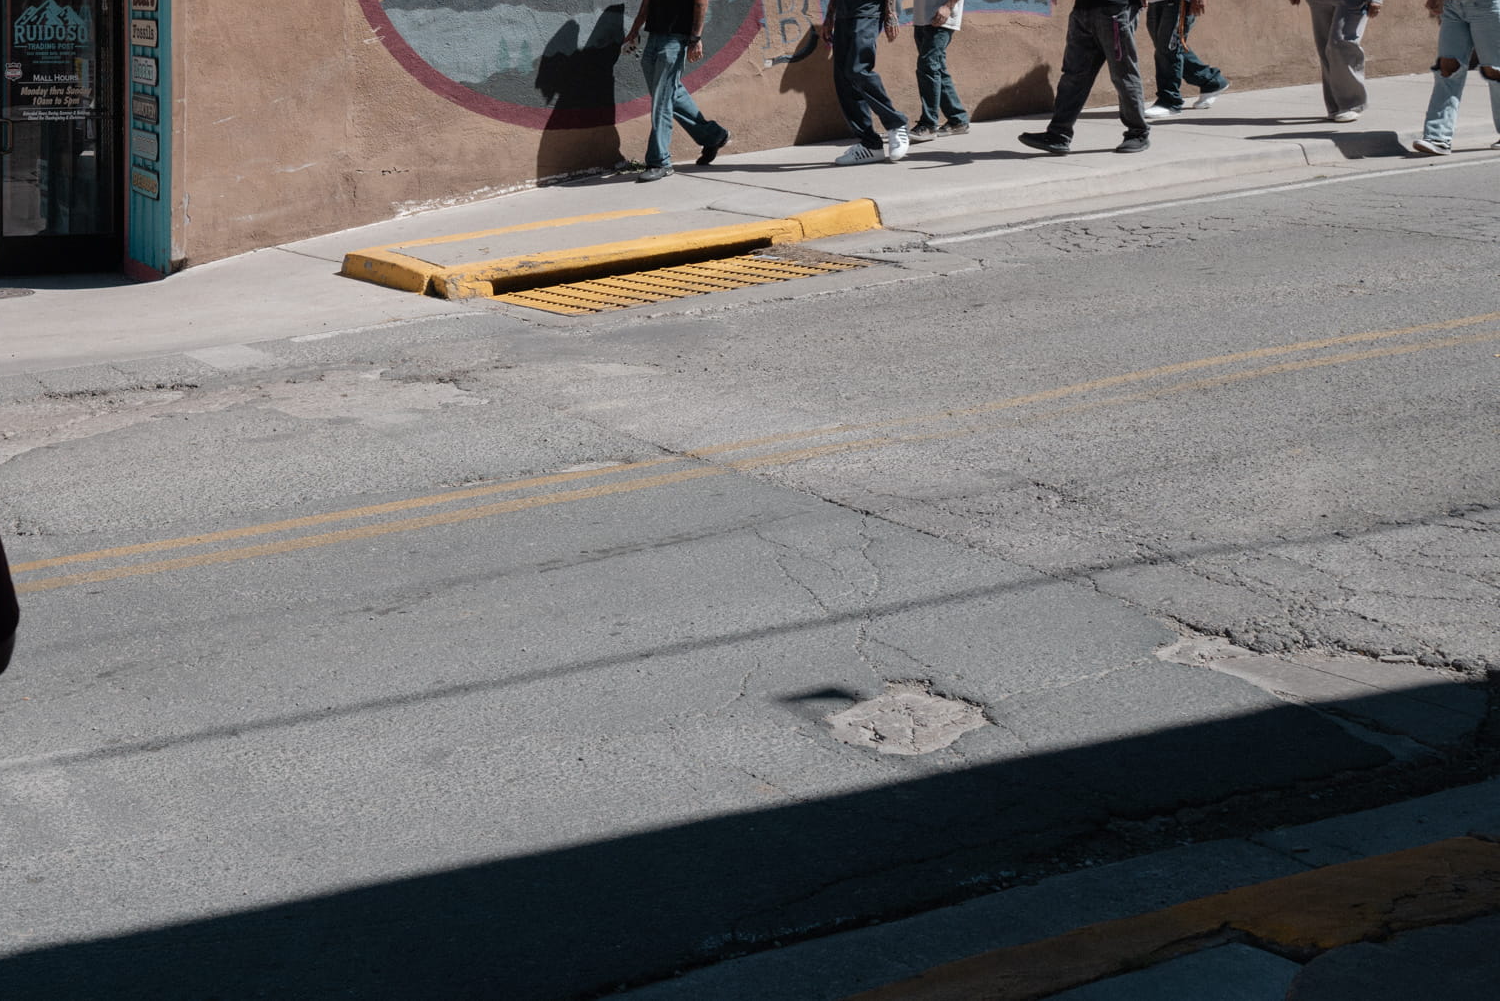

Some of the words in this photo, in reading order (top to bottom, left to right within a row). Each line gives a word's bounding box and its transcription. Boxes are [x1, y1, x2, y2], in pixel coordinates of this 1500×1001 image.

[14, 24, 88, 44] RUIDOSO
[132, 24, 154, 40] Fossils
[27, 42, 57, 50] TRADING
[58, 42, 75, 50] POST
[21, 86, 48, 97] Monday
[49, 85, 64, 95] thru
[65, 85, 92, 97] Sunday
[33, 96, 53, 105] 10am
[54, 96, 62, 105] to
[63, 96, 80, 107] 5pm
